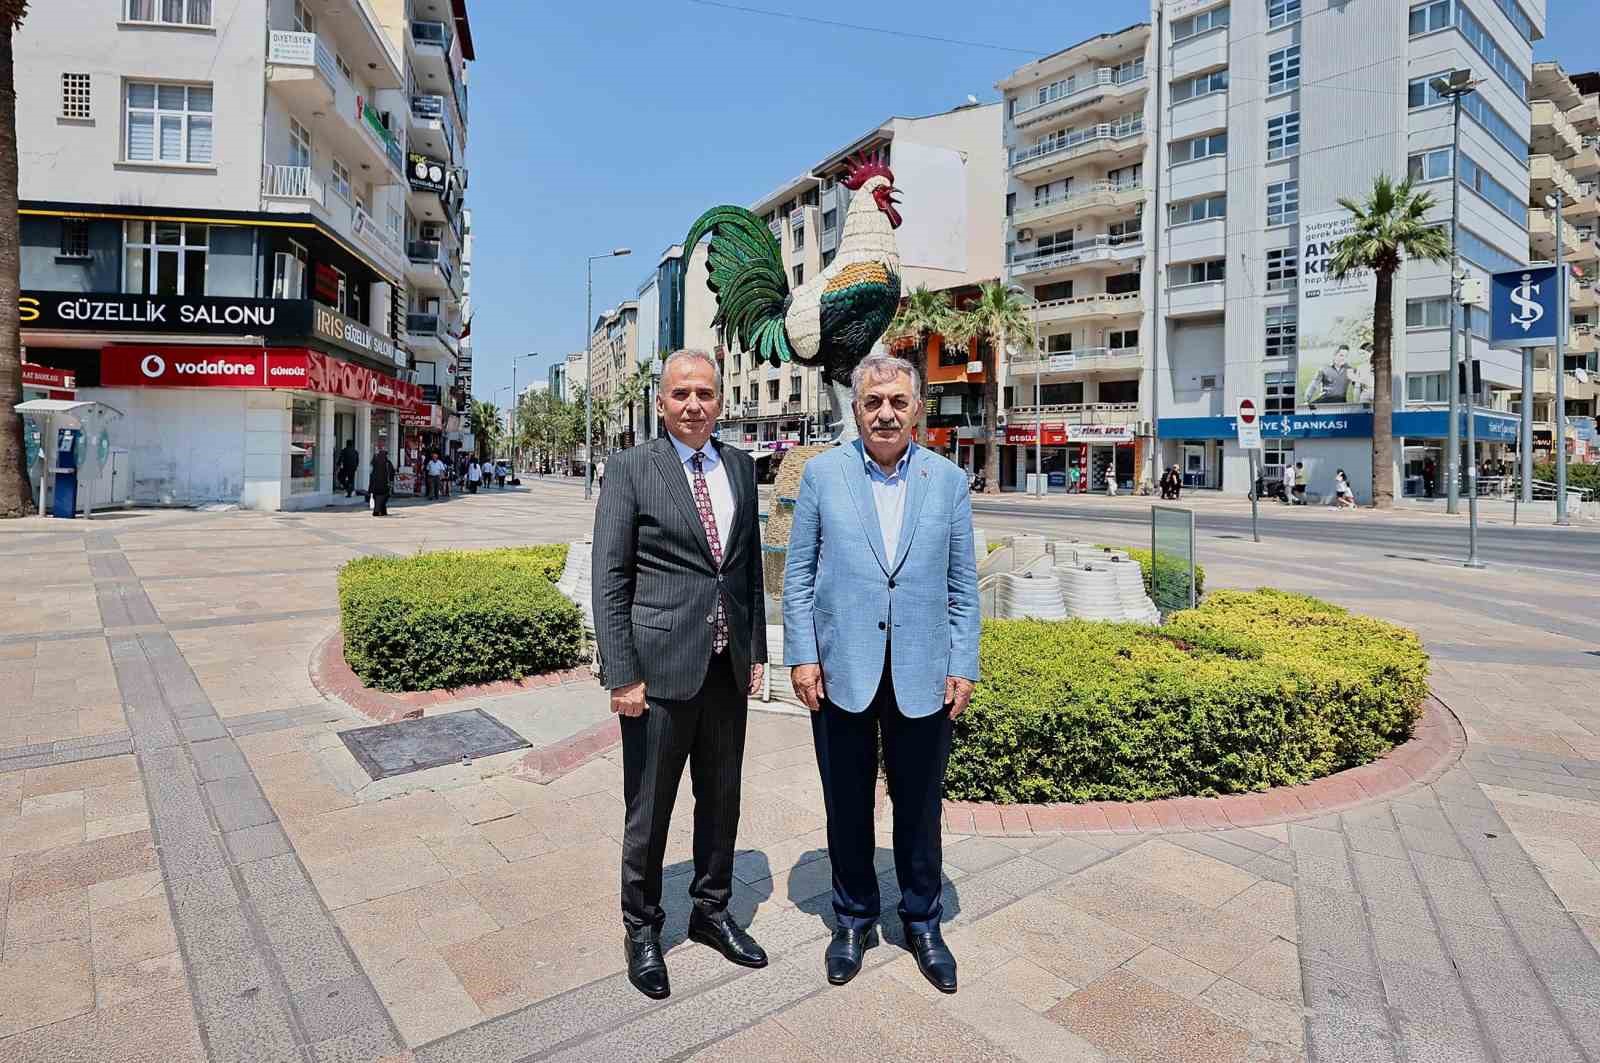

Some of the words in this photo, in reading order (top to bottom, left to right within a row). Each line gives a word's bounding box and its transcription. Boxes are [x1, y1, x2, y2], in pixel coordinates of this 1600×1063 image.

[57, 298, 167, 322] GÜZELLİK
[180, 304, 275, 325] SALONU
[175, 359, 256, 375] vodafone
[270, 366, 306, 376] GÜNDÜZ
[1230, 420, 1278, 431] TİYE
[1293, 420, 1348, 430] BANKASI
